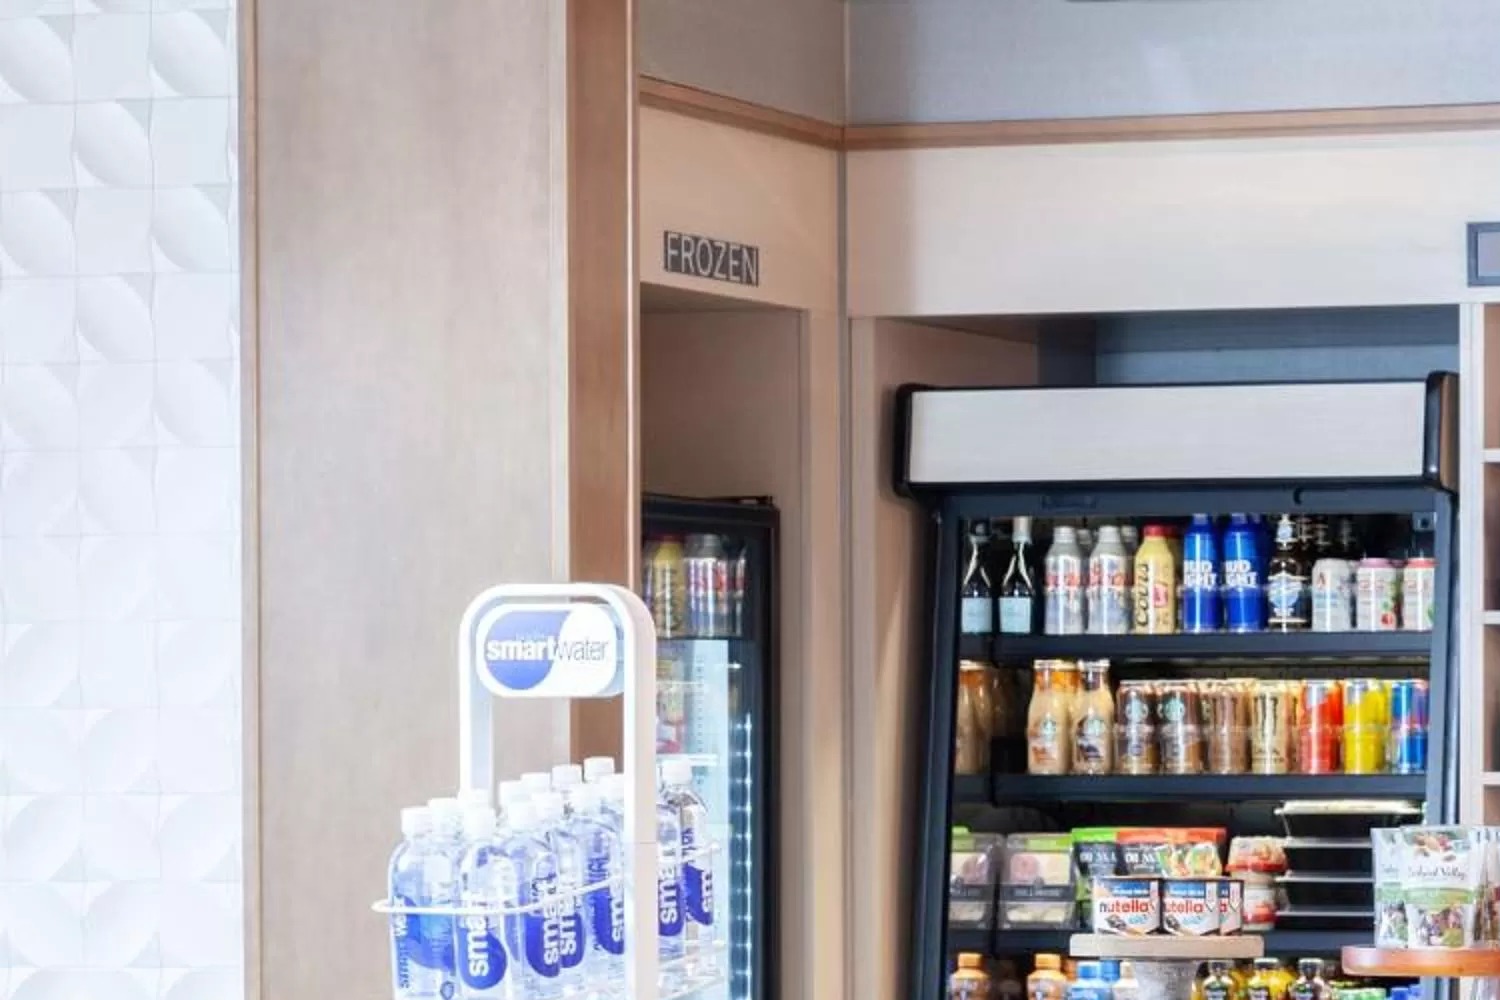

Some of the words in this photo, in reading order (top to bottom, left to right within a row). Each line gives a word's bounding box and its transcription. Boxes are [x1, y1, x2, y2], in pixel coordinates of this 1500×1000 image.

[666, 231, 757, 287] FROZEN
[486, 634, 609, 662] smartwater
[1099, 900, 1149, 914] nutella
